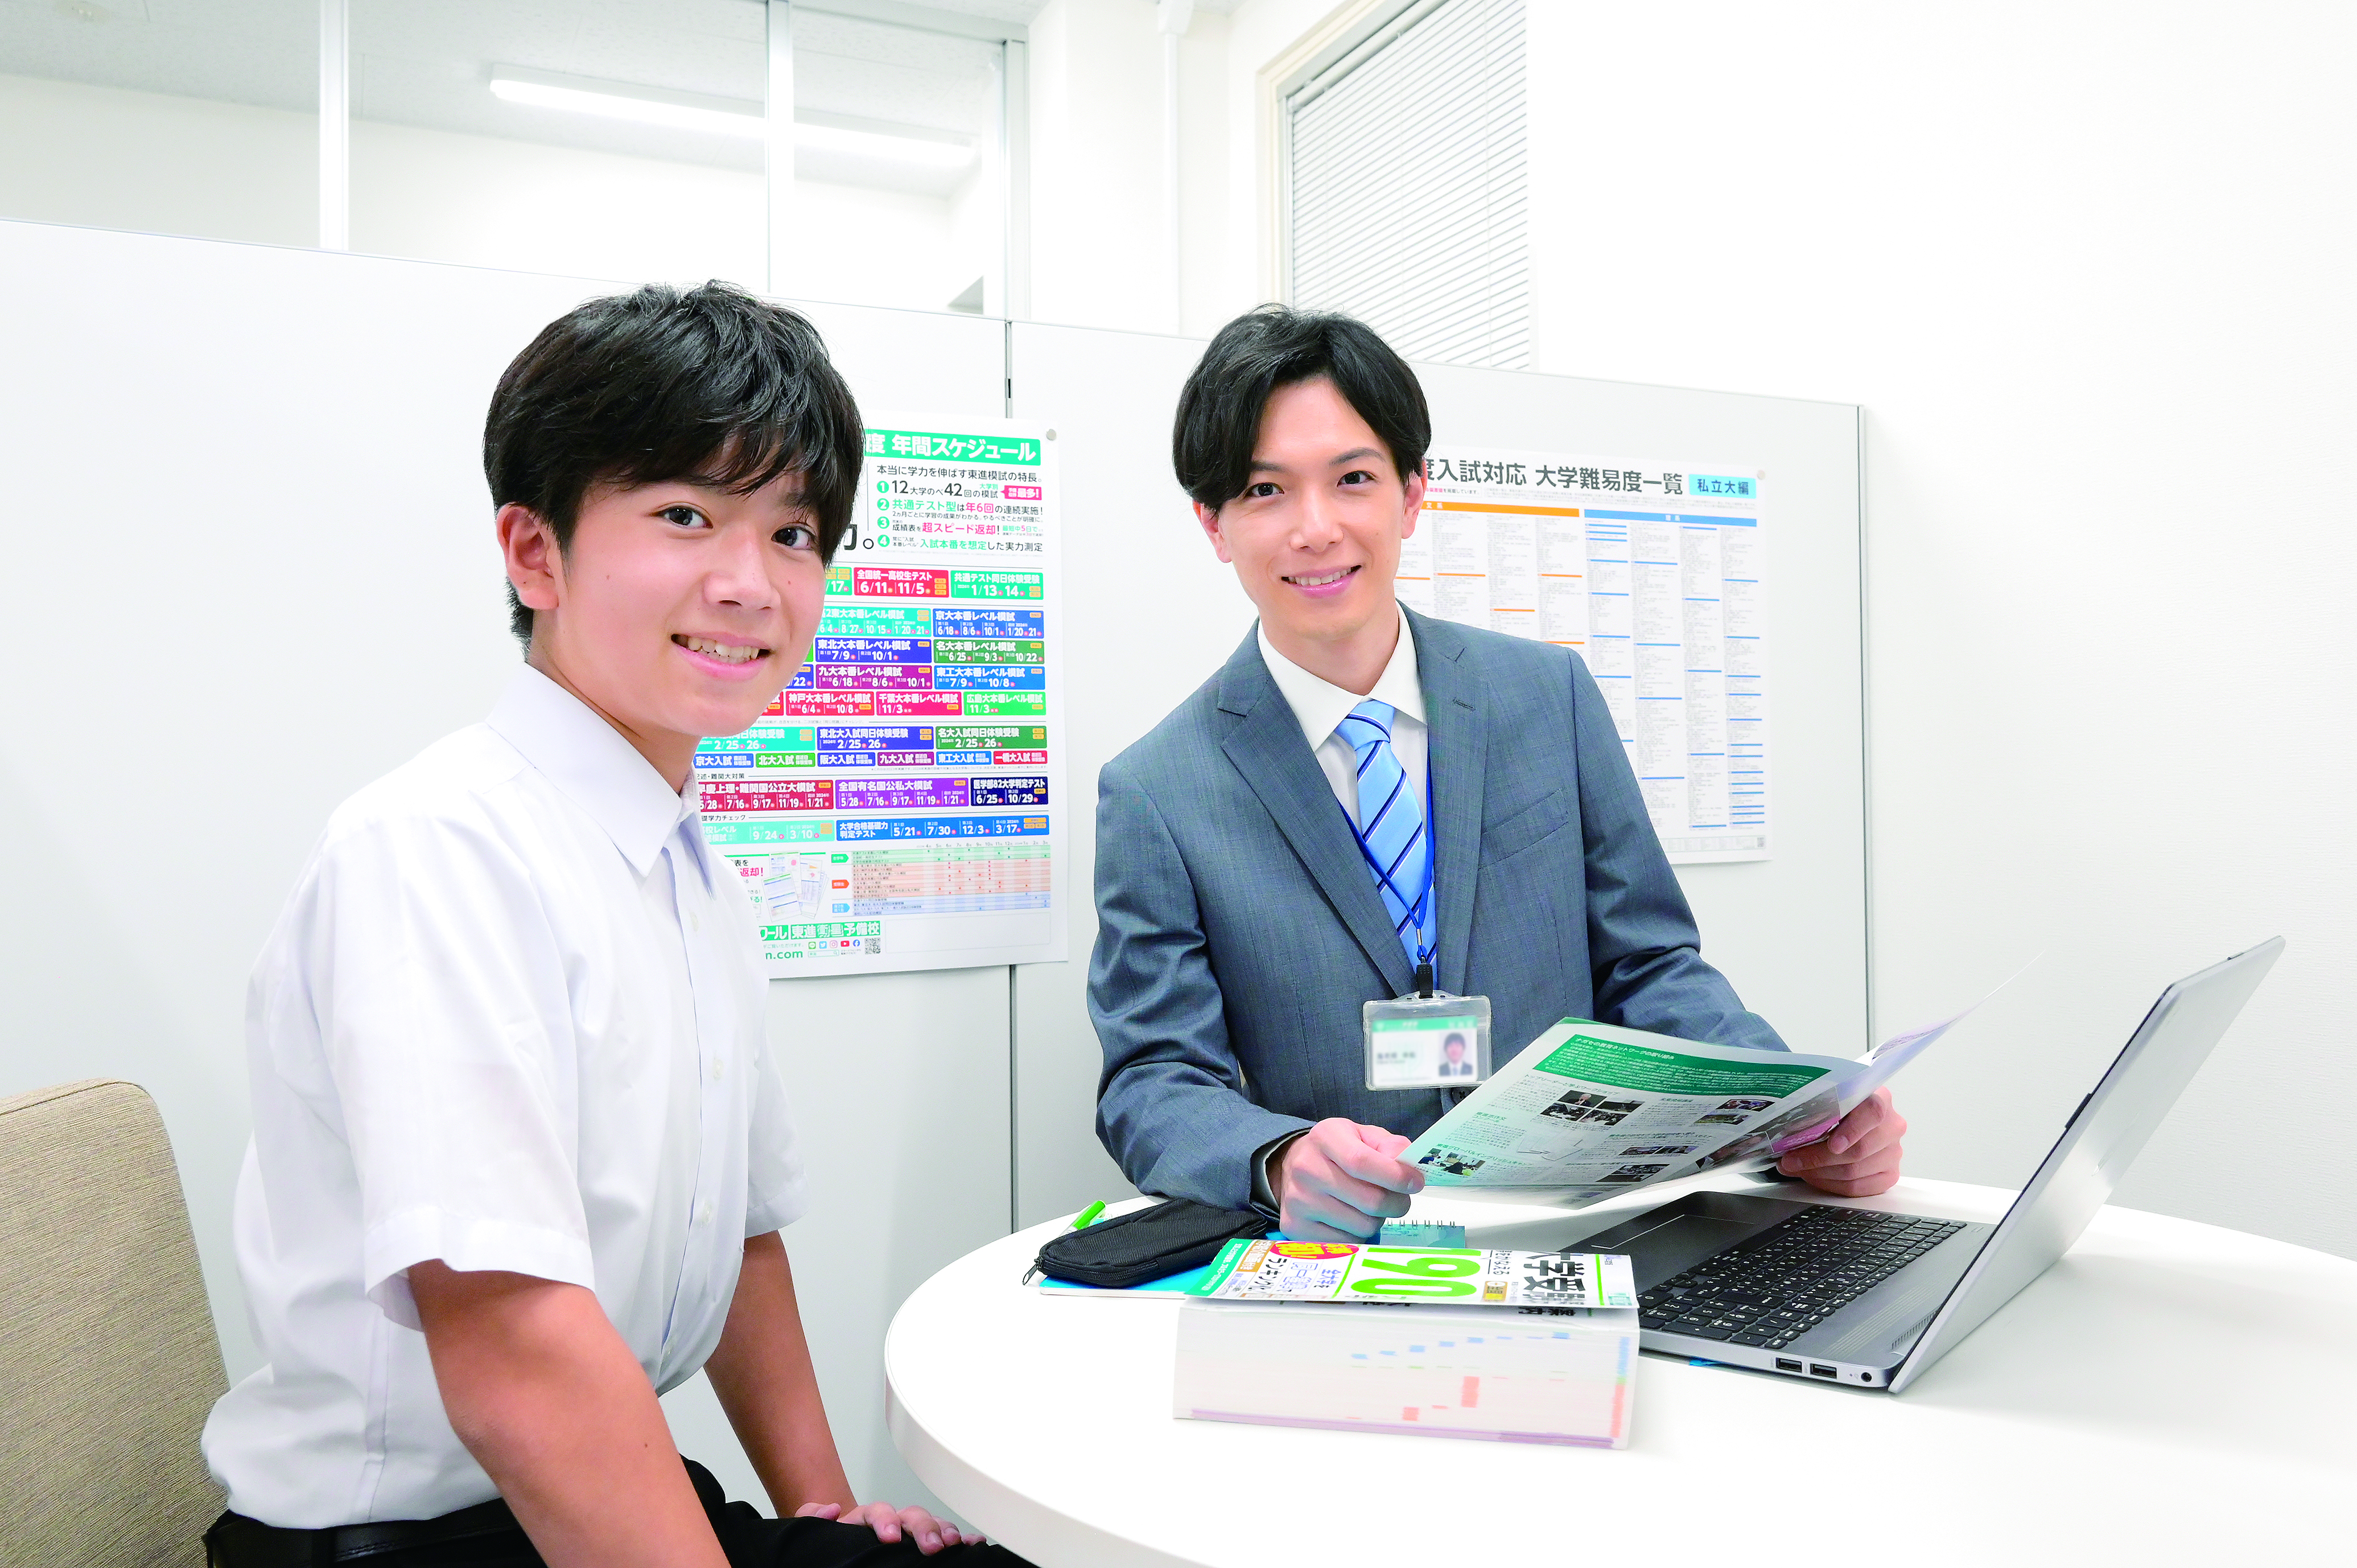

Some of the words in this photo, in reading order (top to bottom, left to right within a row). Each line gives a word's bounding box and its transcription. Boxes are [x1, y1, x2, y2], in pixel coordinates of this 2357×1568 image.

[892, 434, 1036, 461] 年間スケジュール
[877, 465, 1042, 482] 本当に学力を伸ばす東進模試の特長。
[1536, 465, 1683, 494] 大学難易度一覧
[1697, 478, 1749, 494] 私立大編
[920, 538, 1043, 552] 入試本番を想定した実力測定
[857, 570, 932, 581] 全国統一高校生テスト
[954, 572, 1040, 584] 共通テスト同日体験受験
[825, 581, 844, 592] /17
[860, 581, 887, 593] 6/11
[897, 583, 925, 594] 11/5
[971, 585, 998, 596] 1/13
[1005, 585, 1019, 596] 14
[936, 610, 1015, 621] 京大本番レベル模試
[820, 624, 833, 633] 6/4
[842, 625, 859, 633] 8/27
[866, 625, 886, 634] 10/15
[895, 625, 910, 634] 1/20
[917, 626, 925, 634] 21
[938, 626, 954, 635] 6/18
[963, 626, 975, 636] 8/6
[984, 627, 999, 636] 10/1
[1008, 627, 1023, 636] 1/20
[1028, 628, 1037, 637] 21
[818, 639, 910, 650] 東北大本番レベル模試
[936, 641, 1016, 651] 名大本番レベル模試
[832, 650, 850, 660] 7/9
[872, 651, 892, 661] 10/1
[949, 653, 966, 662] 6/25
[984, 653, 998, 662] 9/3
[1015, 653, 1037, 662] 10/22
[819, 666, 902, 676] 九大本番レベル模試
[937, 667, 1025, 677] 東工大本番レベル模試
[788, 676, 806, 687] /22
[832, 677, 852, 687] 6/18
[872, 678, 888, 687] 8/6
[907, 678, 925, 687] 10/1
[950, 678, 967, 687] 7/9
[988, 678, 1009, 687] 10/8
[789, 693, 871, 703] 神戸大本番レベル模試
[879, 694, 958, 703] 千葉大本番レベル模試
[967, 694, 1042, 703] 広島大本番レベル模試
[802, 704, 815, 713] 6/4
[837, 704, 854, 713] 10/8
[883, 705, 903, 713] 11/3
[970, 704, 990, 713] 11/3
[819, 728, 909, 739] 東北大入試同日体験受験
[938, 727, 1019, 738] 名大入試同日体験受験
[714, 740, 739, 749] 2/25
[747, 740, 759, 749] 26
[838, 739, 862, 749] 2/25
[868, 739, 881, 749] 26
[955, 738, 978, 748] 2/25
[984, 738, 996, 748] 26
[695, 756, 732, 766] 京大入試
[759, 755, 794, 765] 北大入試
[820, 755, 855, 765] 阪大入試
[880, 754, 914, 764] 九大入試
[938, 753, 975, 763] 東工大入試
[838, 779, 933, 792] 全国有名国公私大模試
[973, 778, 1045, 790] 医学部82大学判定テスト
[727, 799, 744, 809] 7/16
[753, 799, 771, 808] 9/17
[779, 798, 799, 808] 11/19
[807, 798, 823, 807] 1/21
[841, 797, 859, 807] 5/28
[867, 797, 884, 806] 7/16
[892, 796, 909, 805] 9/17
[917, 795, 936, 805] 11/19
[944, 795, 959, 804] 1/21
[976, 794, 998, 804] 6/25
[1008, 793, 1033, 803] 10/29
[839, 821, 888, 831] 大学合格基礎力
[893, 827, 916, 836] 5/21
[927, 826, 951, 836] 7/30
[962, 825, 984, 835] 12/3
[996, 824, 1017, 834] 3/17
[753, 831, 777, 840] 9/24
[790, 830, 813, 839] 3/10
[839, 830, 876, 839] 判定テスト
[792, 922, 880, 939] 東進衛星予備校
